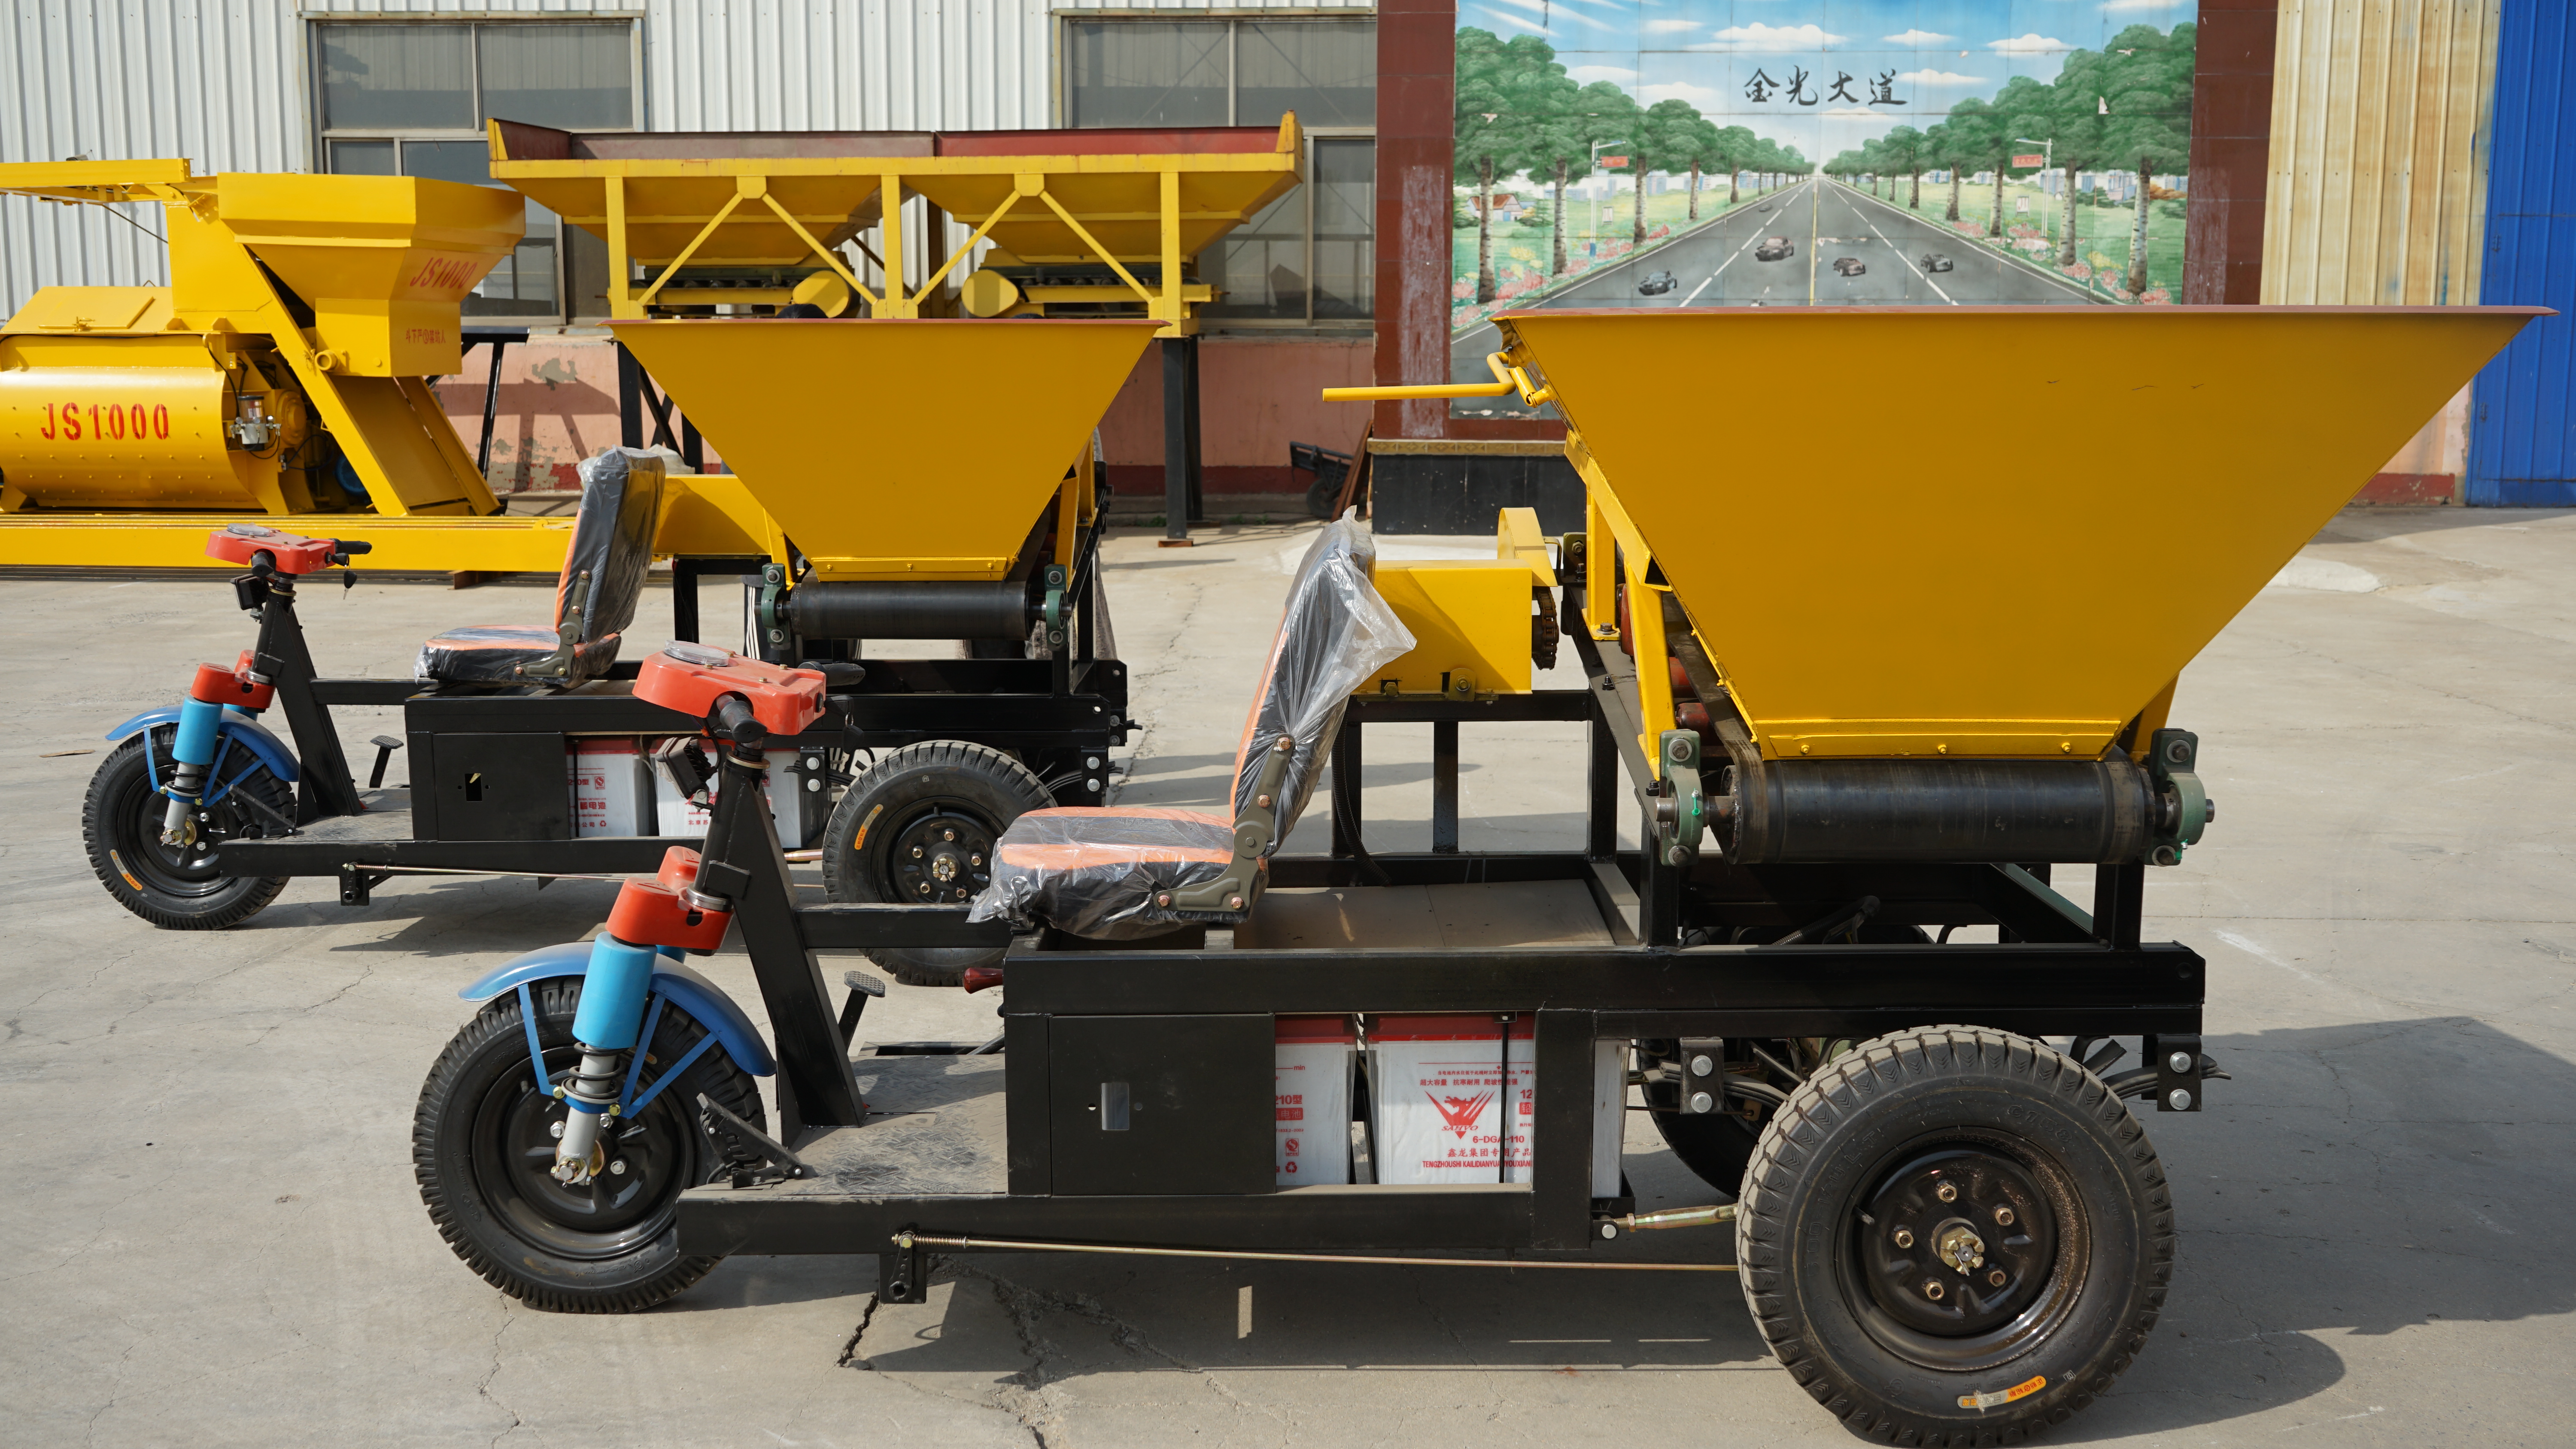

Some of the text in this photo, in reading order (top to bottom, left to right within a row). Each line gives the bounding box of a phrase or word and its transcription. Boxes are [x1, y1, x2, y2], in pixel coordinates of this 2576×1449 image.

[1744, 65, 1908, 106] 金光大道
[410, 258, 477, 289] JS1000
[41, 402, 168, 440] JS1000
